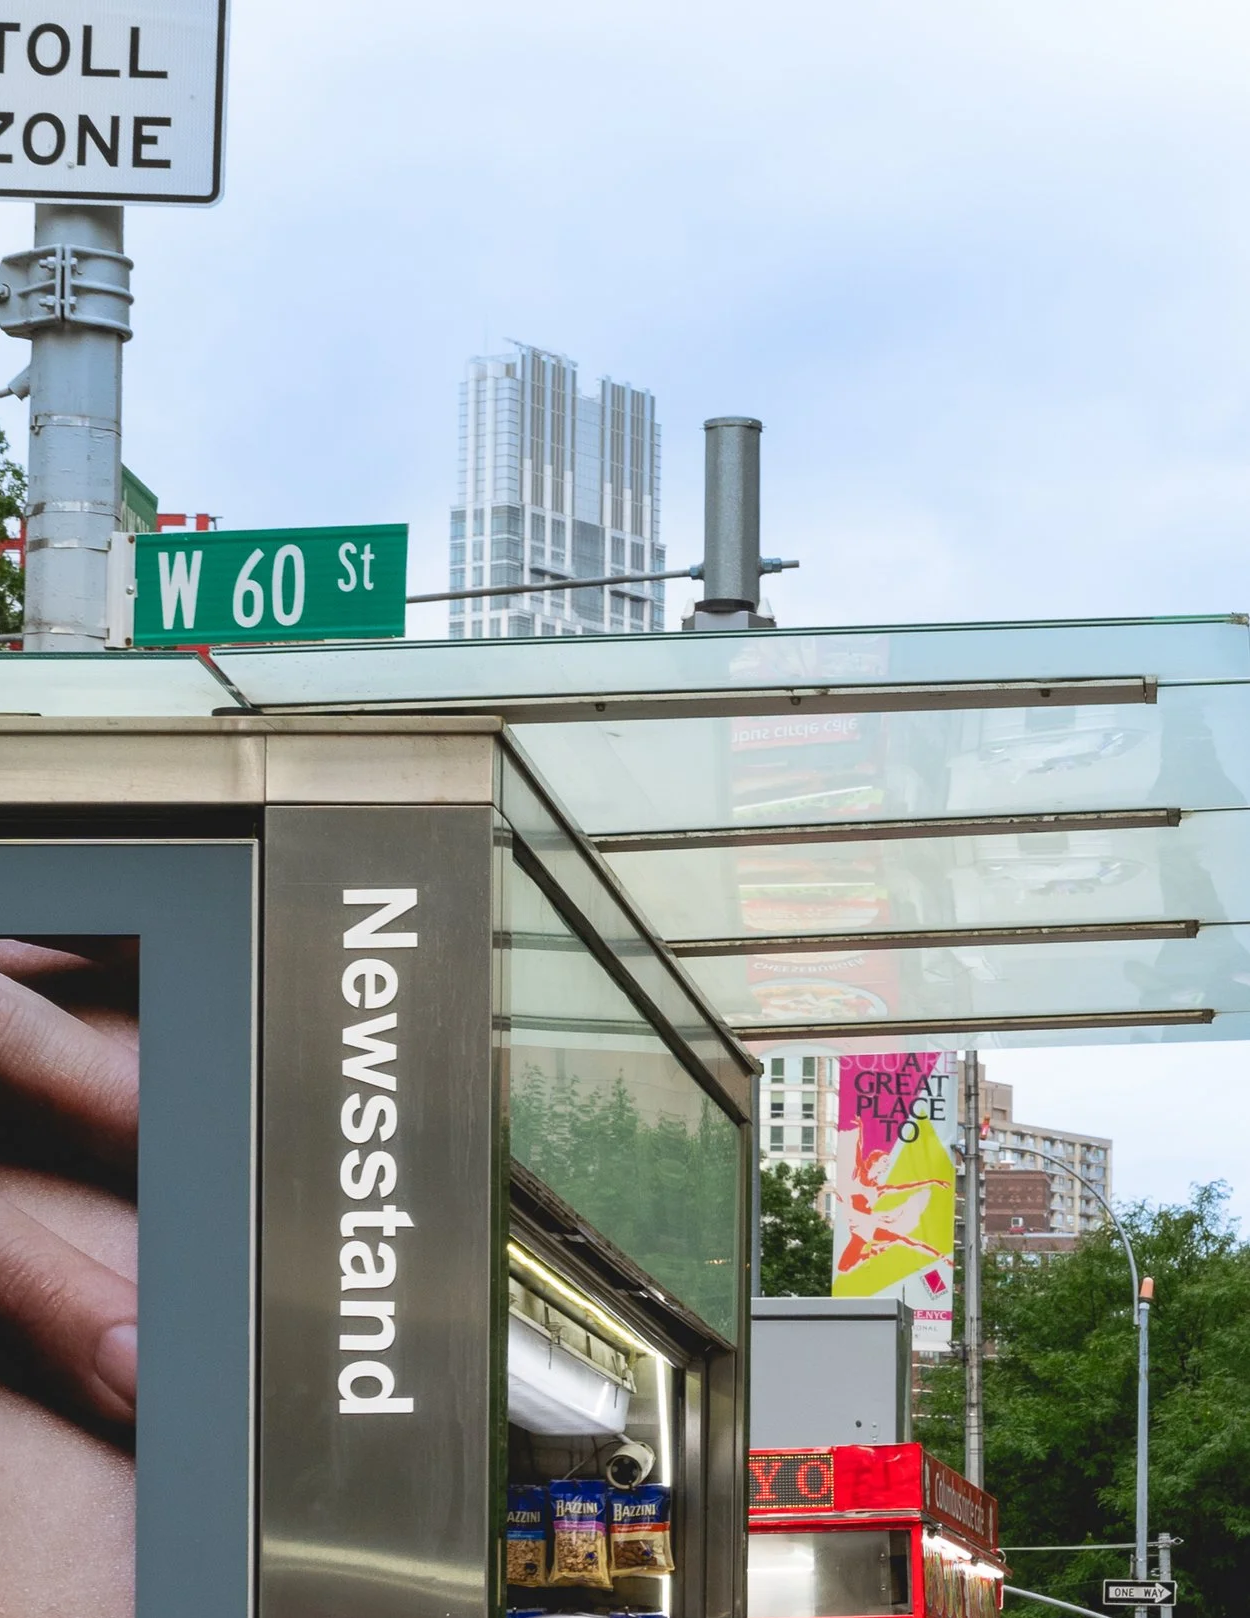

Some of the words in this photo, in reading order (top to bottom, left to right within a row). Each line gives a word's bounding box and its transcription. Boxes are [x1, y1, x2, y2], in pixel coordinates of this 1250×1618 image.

[157, 550, 203, 631] W
[232, 544, 306, 629] 60
[336, 542, 376, 593] St
[901, 1052, 922, 1073] A
[854, 1070, 949, 1097] GREAT
[856, 1094, 946, 1121] PLACE
[879, 1119, 920, 1143] TO
[337, 887, 419, 1415] Newsstand
[913, 1310, 947, 1320] E.NYC
[506, 1510, 542, 1524] AZZINI
[555, 1499, 599, 1518] BAZZINI
[613, 1503, 656, 1522] BAZZINI
[1114, 1587, 1135, 1598] ONE
[1143, 1587, 1165, 1598] WAY
